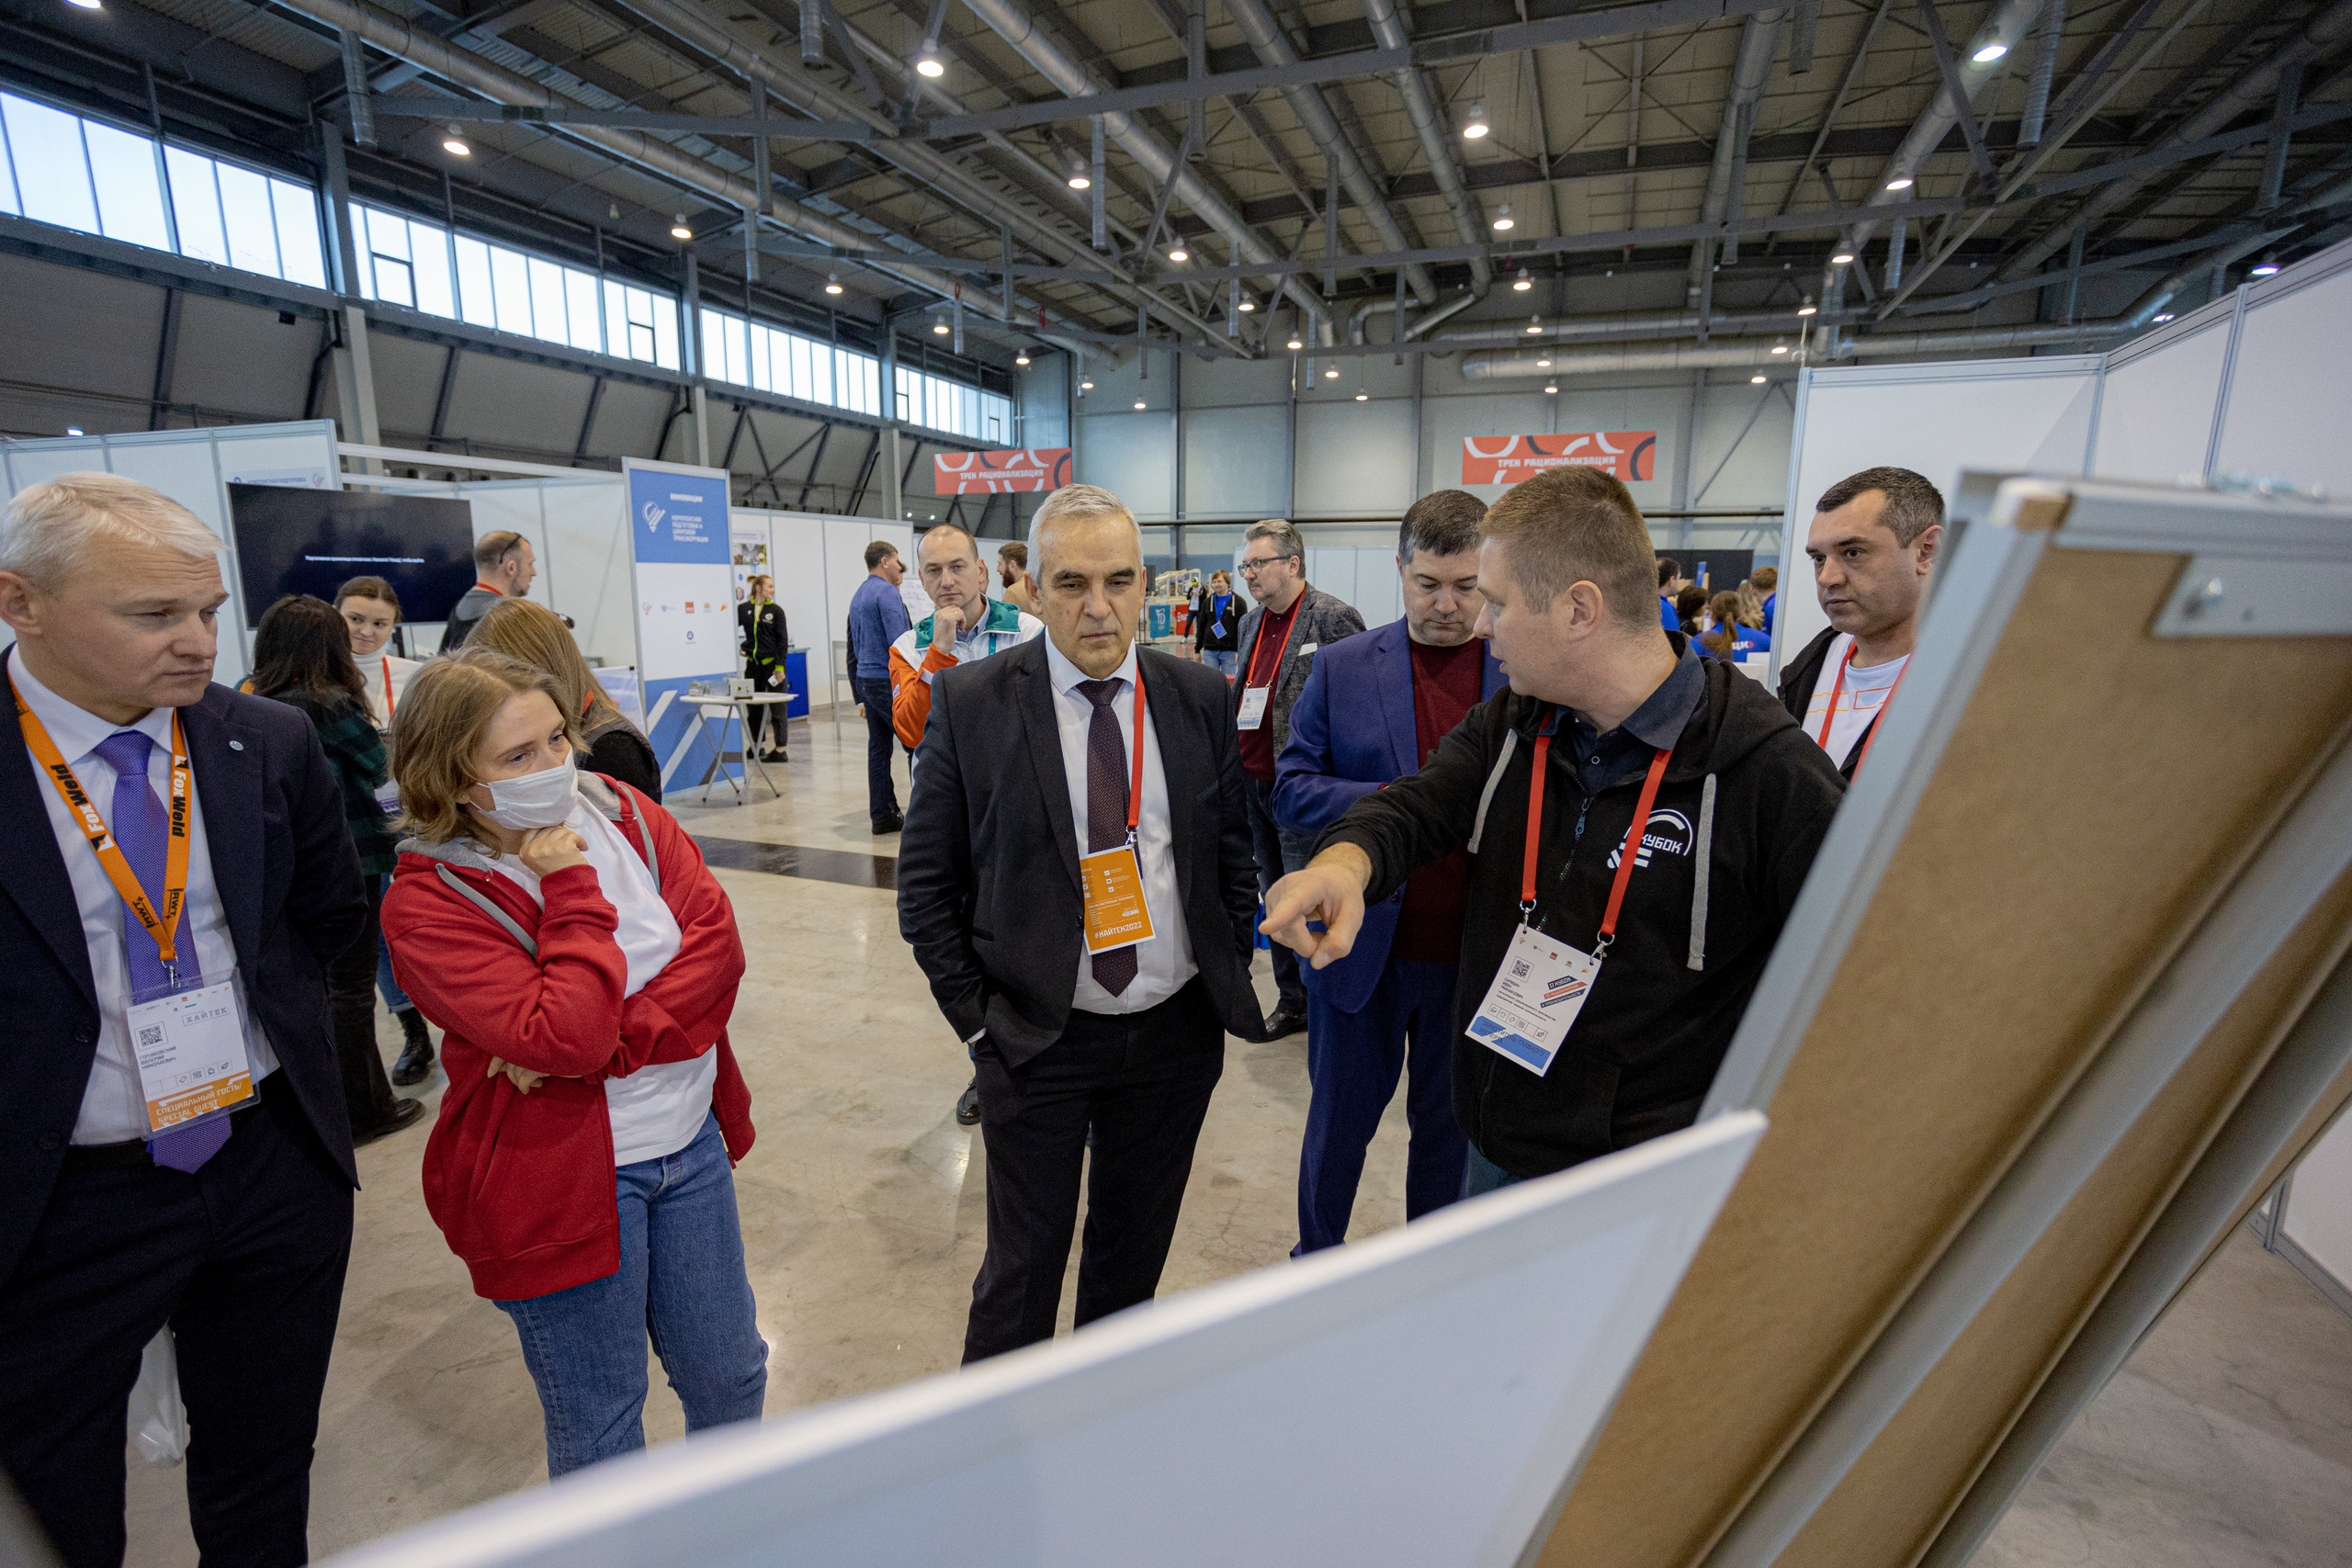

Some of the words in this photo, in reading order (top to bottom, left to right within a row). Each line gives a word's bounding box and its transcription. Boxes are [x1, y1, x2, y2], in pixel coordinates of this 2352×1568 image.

[1498, 458, 1521, 468] ТРЕК
[1524, 456, 1616, 467] РАЦИОНАЛИЗАЦИЯ
[960, 471, 977, 479] ТРЕК
[978, 469, 1044, 479] РАЦИОНАЛИЗАЦИЯ
[1732, 640, 1749, 650] ЦК
[51, 763, 105, 832] FoxWeld
[172, 770, 187, 838] FoxWeld
[1642, 833, 1683, 854] КУБОК
[187, 1007, 228, 1023] ХАЙТЕК
[156, 1090, 216, 1116] СПЕЦИАЛЬНЫЙ
[158, 1110, 192, 1124] SPECIAL
[194, 1099, 218, 1112] GUEST
